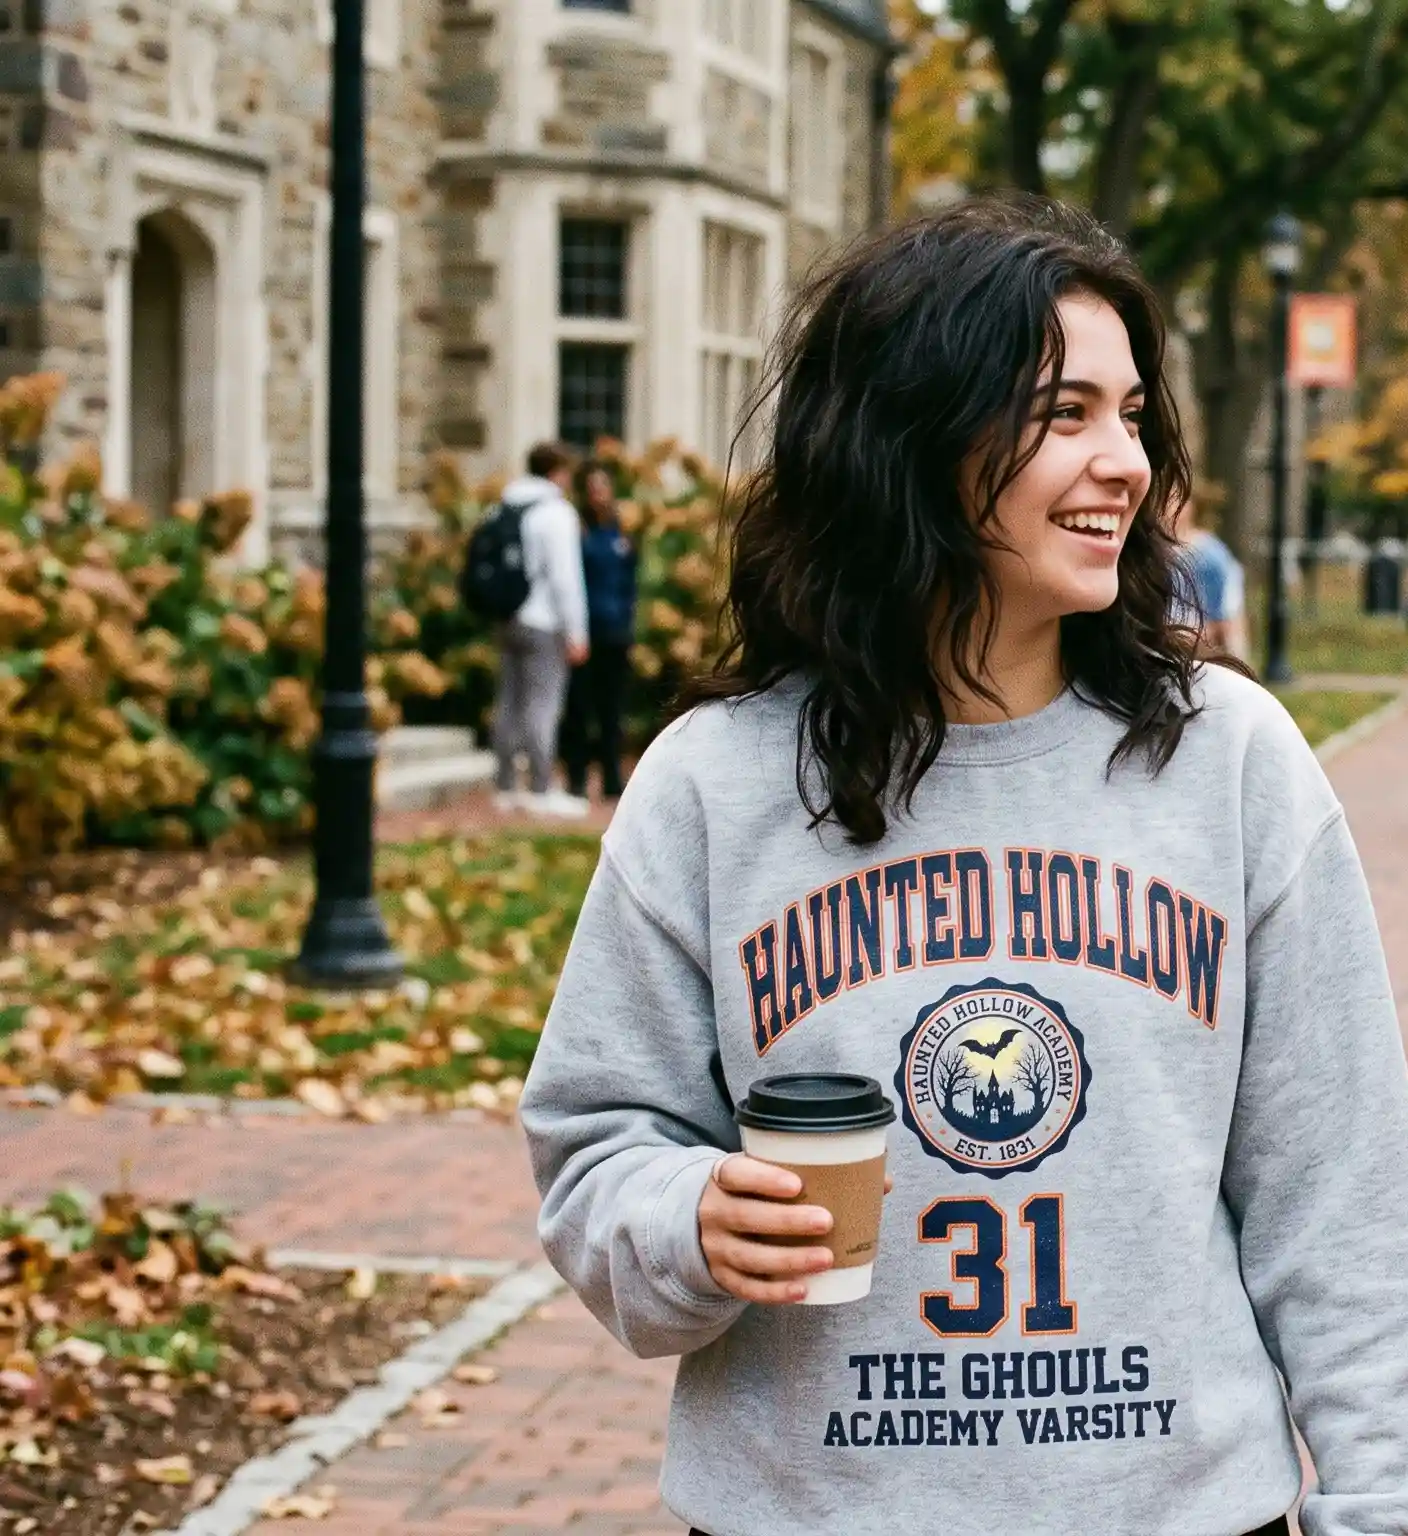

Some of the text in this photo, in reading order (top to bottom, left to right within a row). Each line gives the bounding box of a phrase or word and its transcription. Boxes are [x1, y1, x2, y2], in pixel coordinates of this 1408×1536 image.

[739, 847, 1227, 1057] HAUNTED HOLLOW
[912, 997, 1073, 1104] HAUNTED HOLLOW ACADEMY
[954, 1136, 1036, 1160] EST. 1831
[917, 1192, 1077, 1338] 31
[849, 1345, 1149, 1400] THE GHOULS
[824, 1399, 1176, 1447] ACADEMY VARSITY
